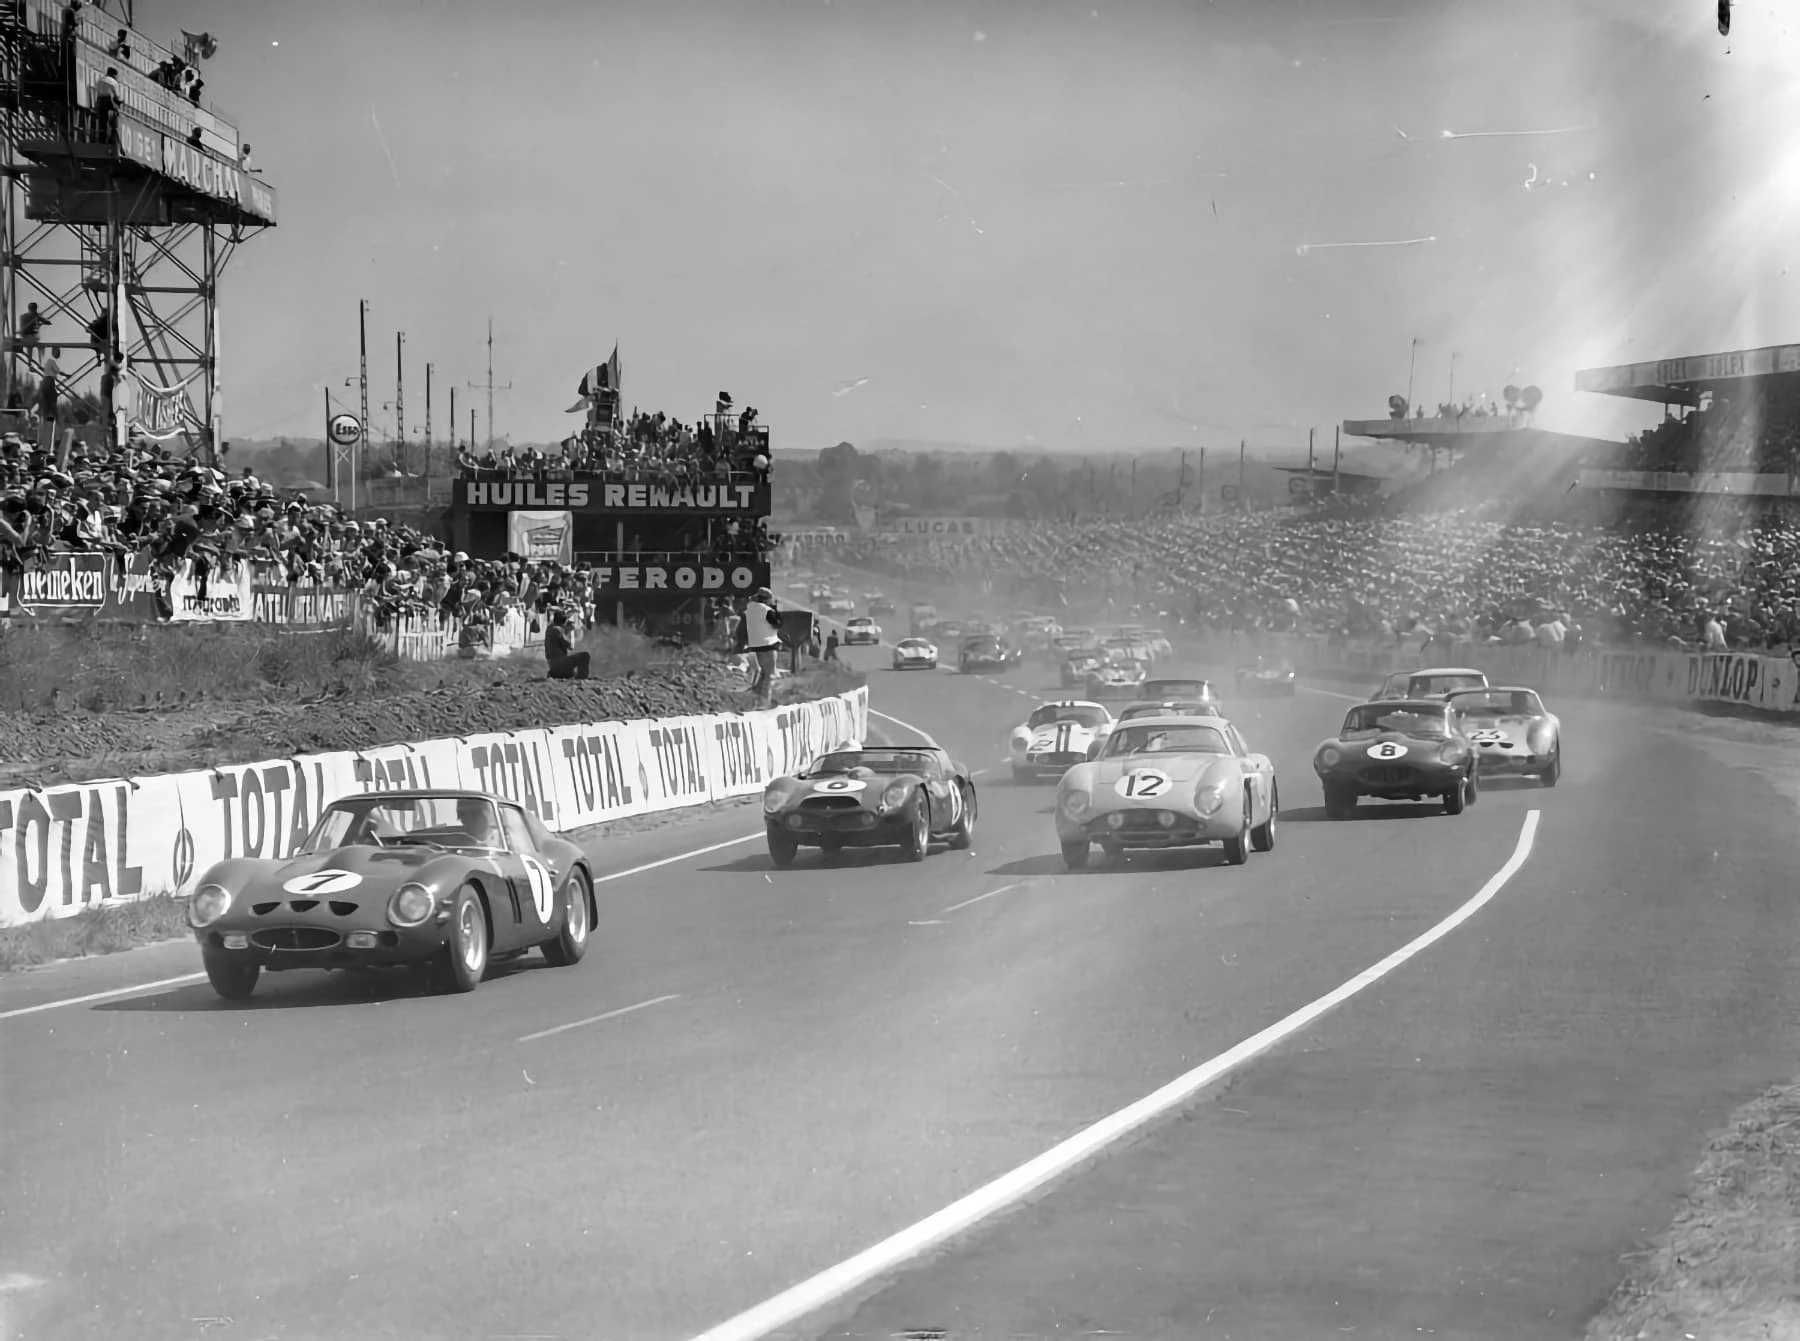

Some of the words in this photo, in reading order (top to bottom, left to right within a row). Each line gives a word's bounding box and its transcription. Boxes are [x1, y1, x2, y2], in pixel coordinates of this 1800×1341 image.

[467, 482, 589, 506] HUILES
[604, 484, 755, 508] RENAULT
[592, 566, 753, 589] FERODO
[1688, 656, 1759, 700] DUNLOP
[649, 726, 706, 798] TOTAL
[715, 721, 761, 788] TOTAL
[1380, 744, 1396, 757] 8
[471, 741, 554, 820] TOTAL
[562, 733, 632, 815] TOTAL
[1126, 775, 1164, 797] 12
[302, 873, 347, 891] 7
